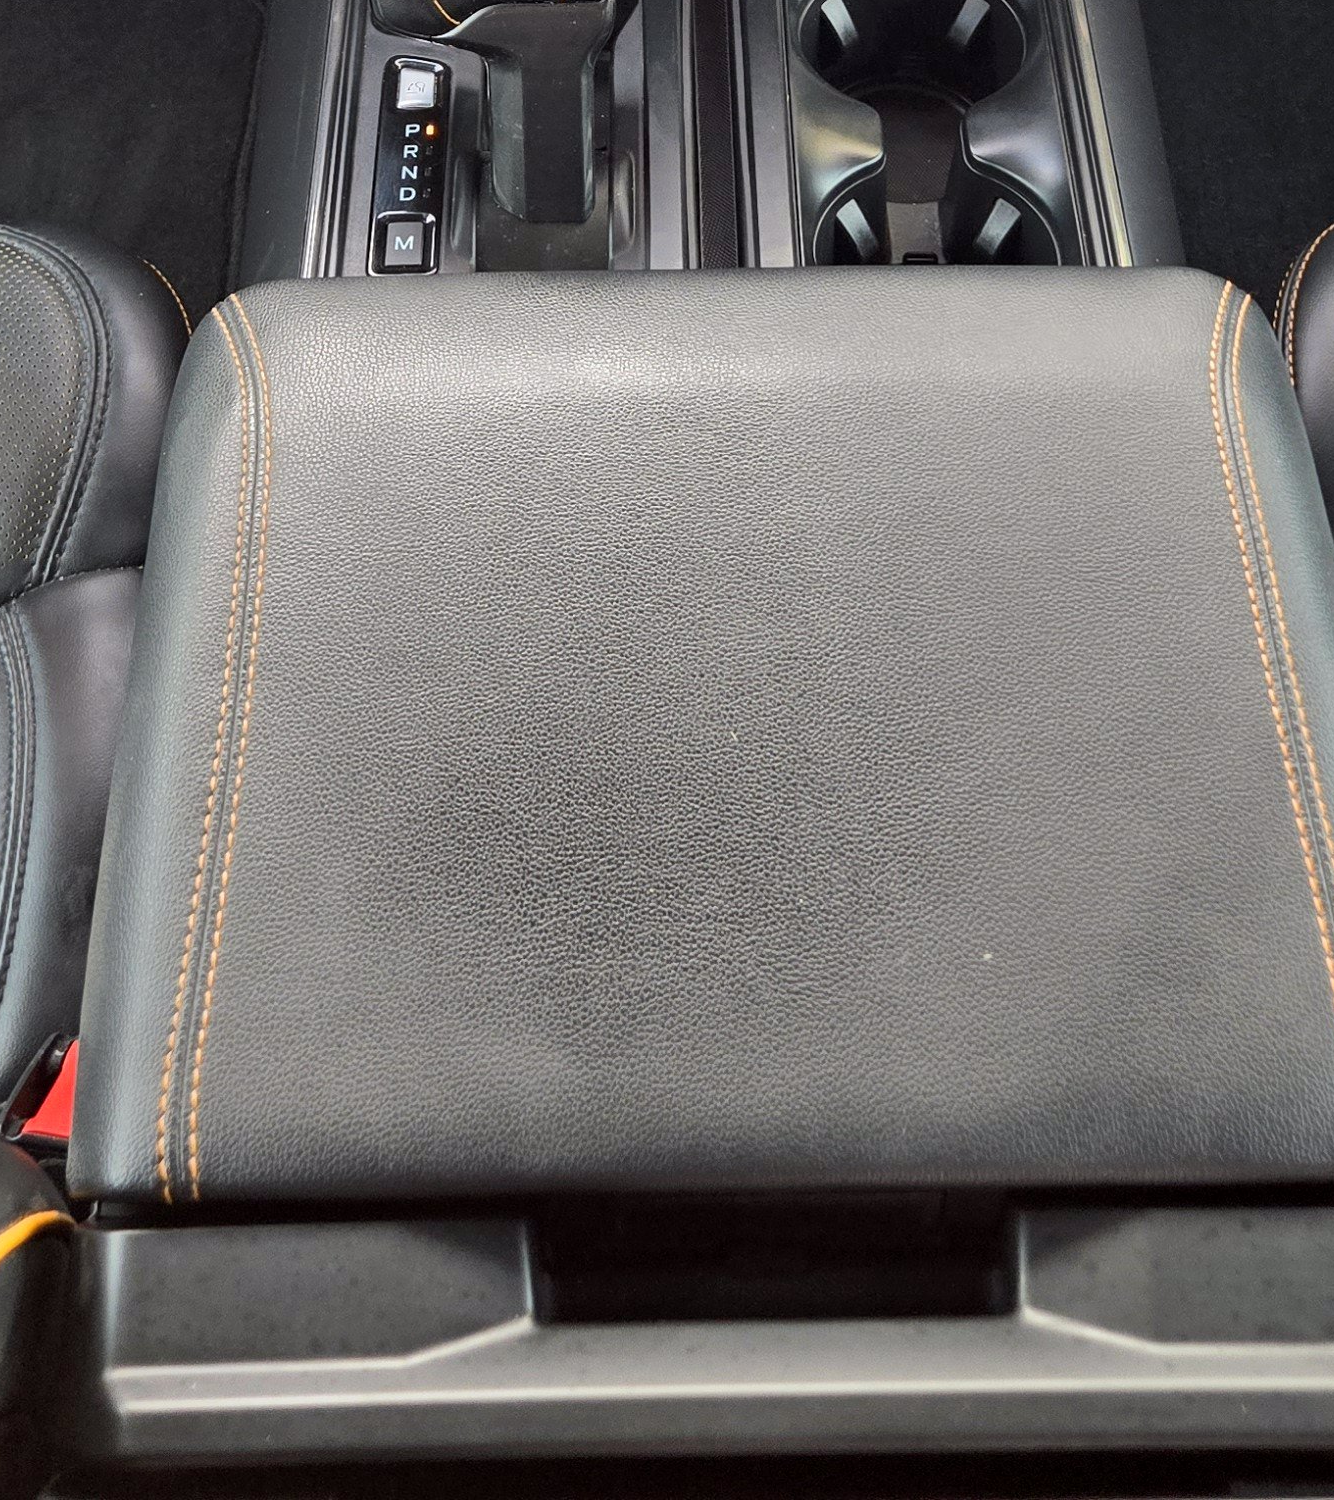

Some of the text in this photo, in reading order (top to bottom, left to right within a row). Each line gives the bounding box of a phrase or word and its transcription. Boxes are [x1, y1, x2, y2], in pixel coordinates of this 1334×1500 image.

[405, 124, 421, 137] P
[403, 145, 419, 158] R
[401, 166, 417, 180] N
[399, 187, 416, 200] D
[394, 235, 415, 250] M
